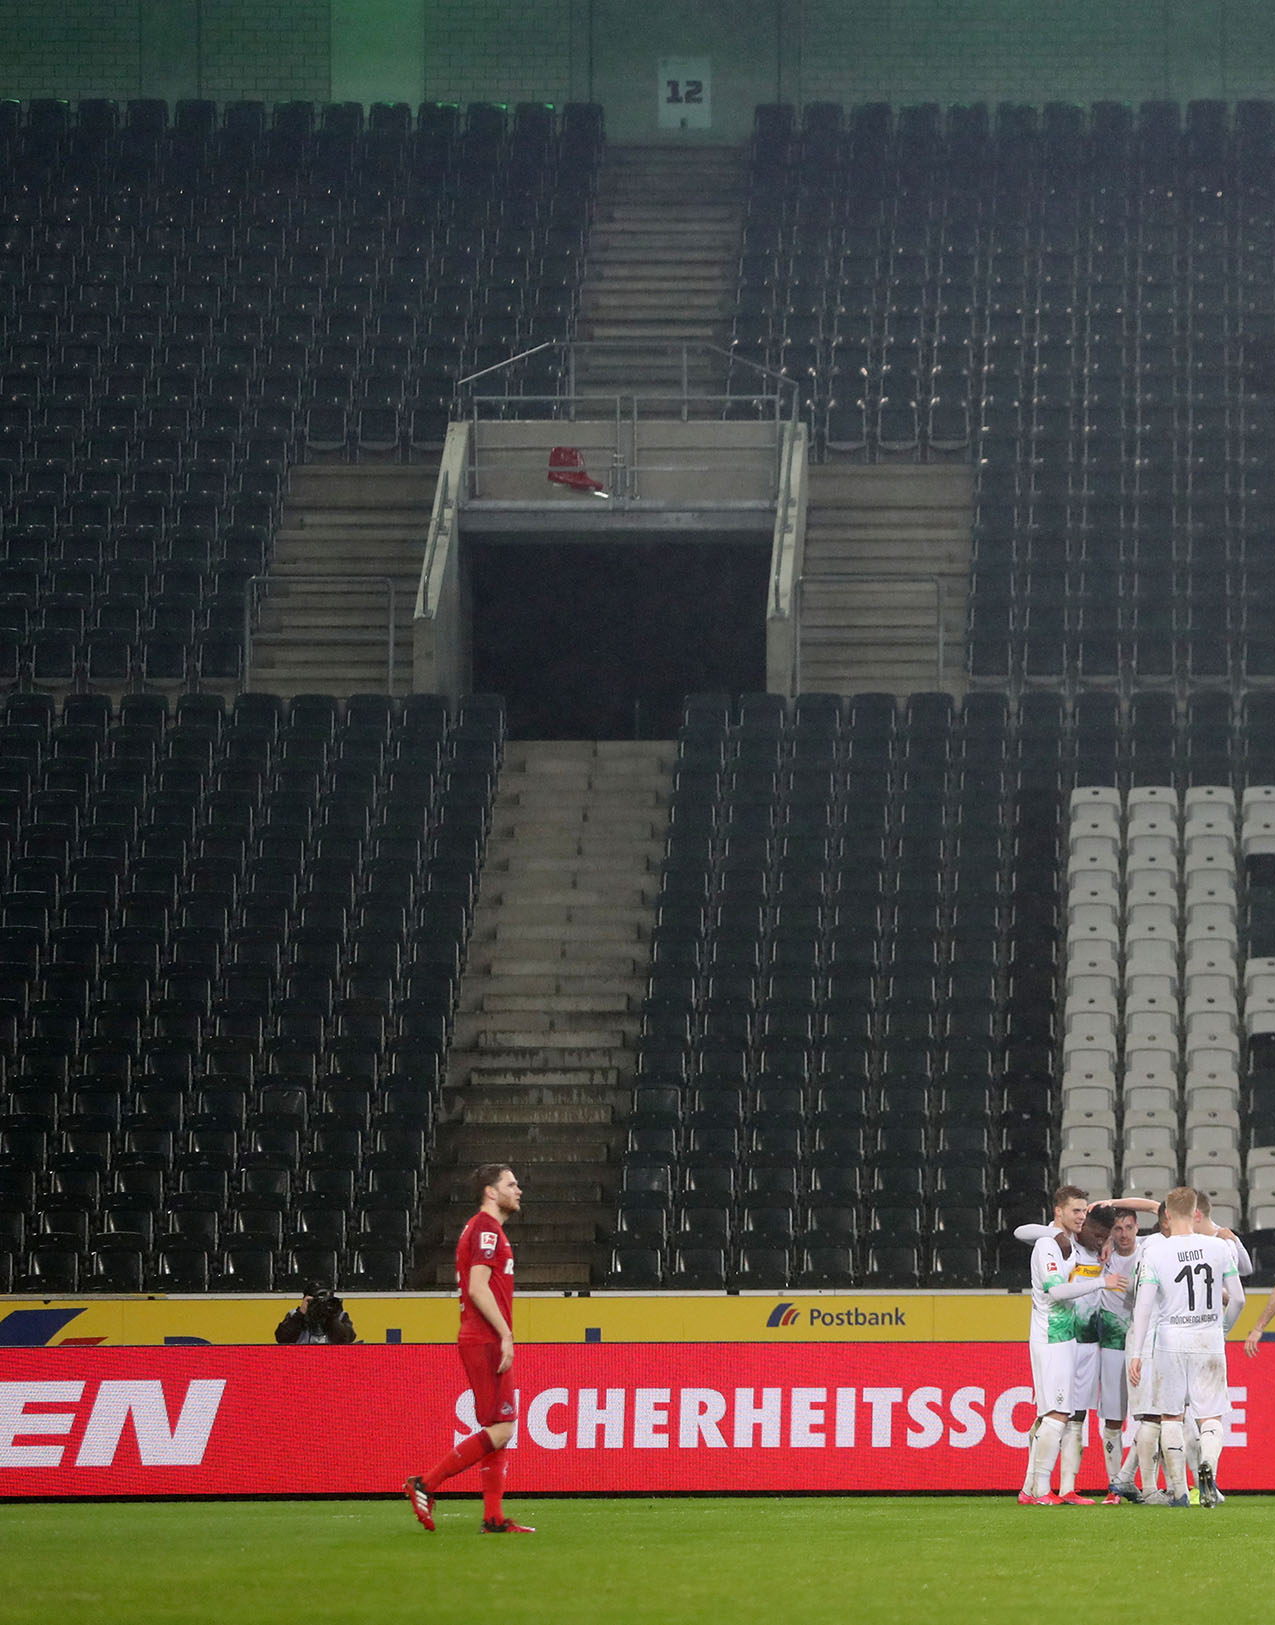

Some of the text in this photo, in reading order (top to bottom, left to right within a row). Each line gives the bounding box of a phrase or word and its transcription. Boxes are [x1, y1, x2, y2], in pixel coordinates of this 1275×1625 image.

[666, 79, 704, 104] 12
[1177, 1248, 1204, 1263] WENDT
[1174, 1262, 1215, 1312] 17
[808, 1306, 906, 1327] Postbank
[0, 1378, 227, 1468] EN
